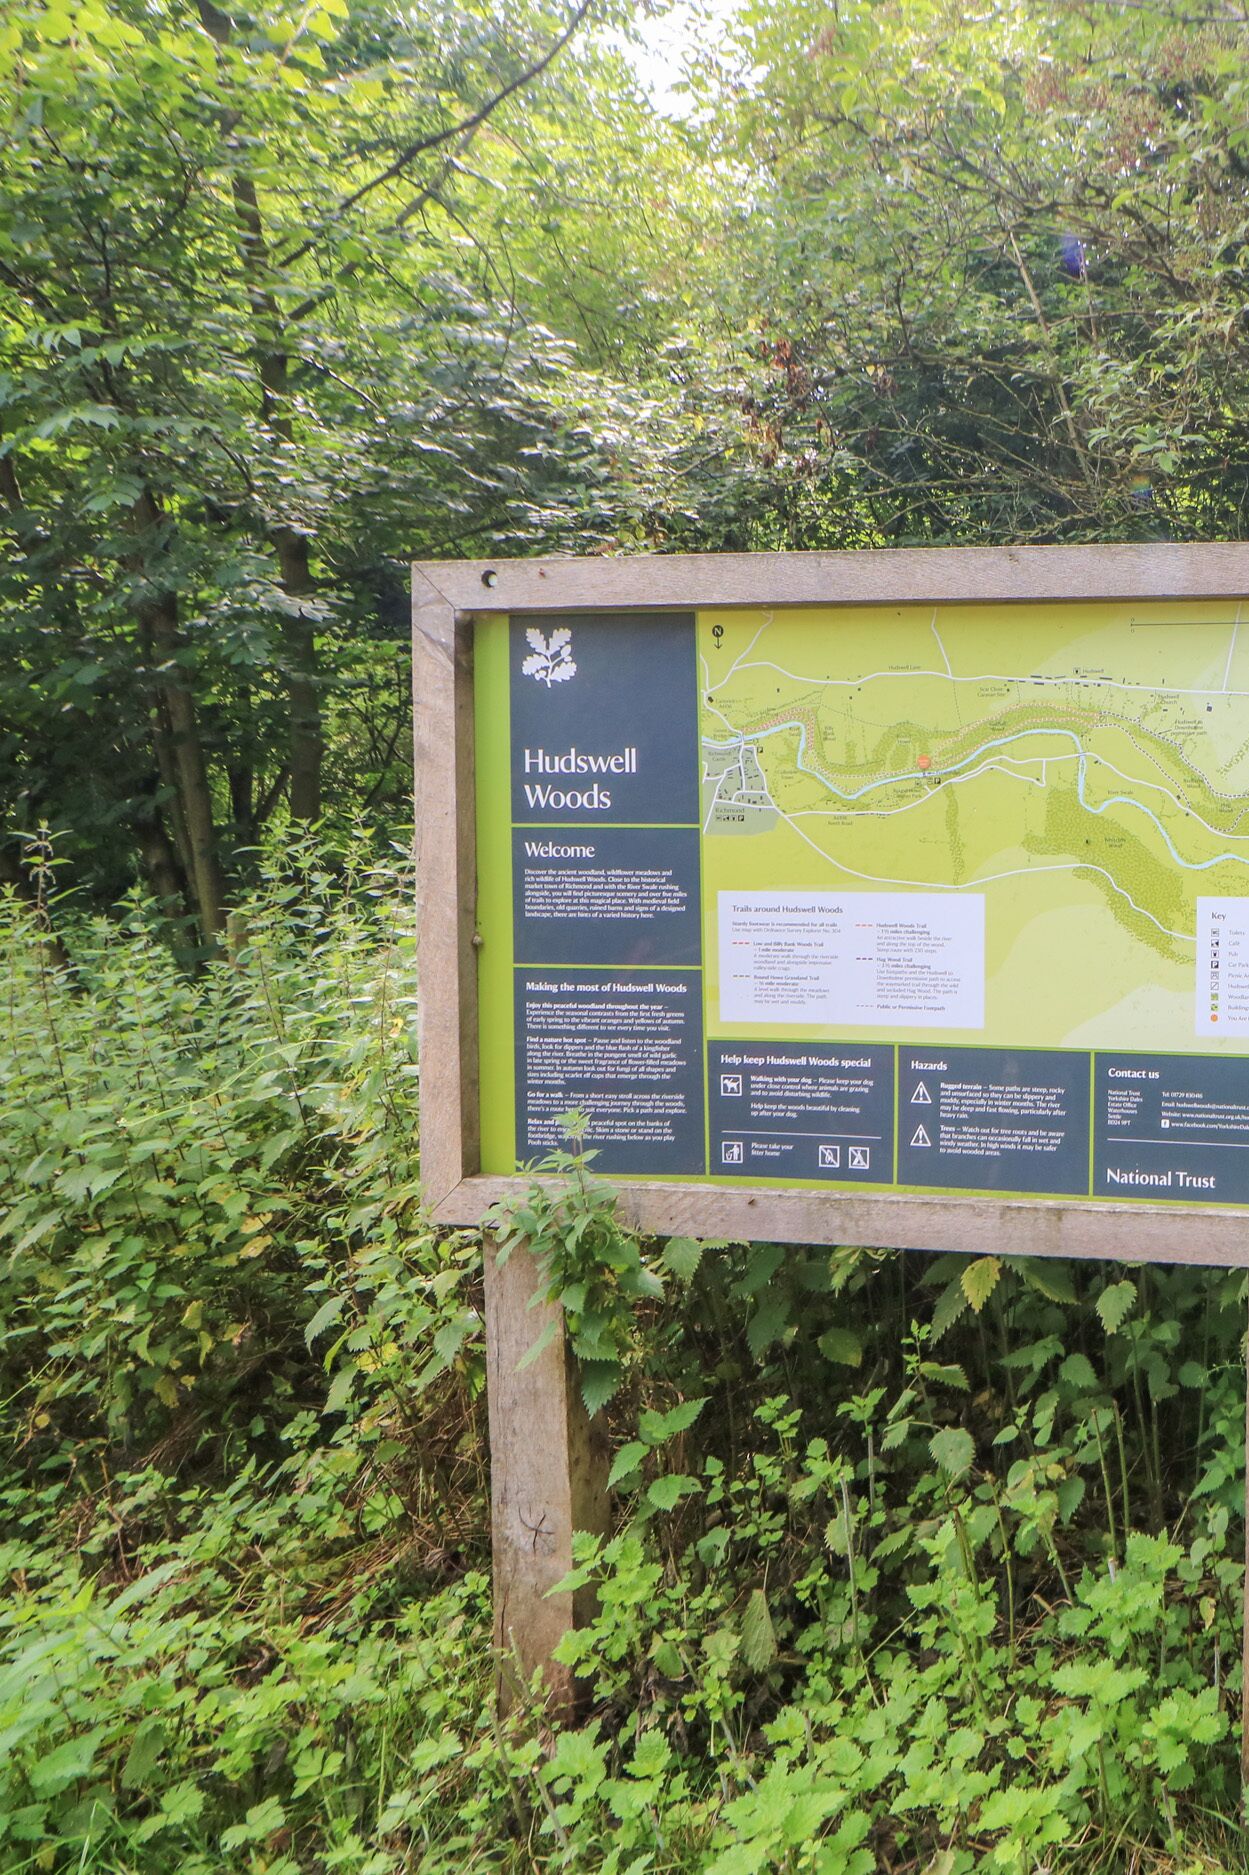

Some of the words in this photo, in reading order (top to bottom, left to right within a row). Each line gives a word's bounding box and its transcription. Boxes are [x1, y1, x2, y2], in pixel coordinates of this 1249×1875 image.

[524, 748, 637, 773] Hudswell
[524, 784, 611, 808] Woods
[525, 842, 595, 858] Welcome
[658, 883, 680, 892] rushing
[732, 905, 752, 913] Trails
[753, 905, 780, 913] around
[781, 905, 816, 913] Hudswell
[817, 906, 843, 914] Woods
[1212, 912, 1226, 921] Key
[526, 982, 558, 994] Making
[559, 982, 575, 991] the
[576, 983, 599, 992] most
[600, 983, 611, 992] of
[612, 983, 654, 992] Hudswell
[655, 983, 687, 993] Woods
[547, 1023, 576, 1032] something
[720, 1055, 742, 1067] Help
[743, 1055, 764, 1067] keep
[765, 1056, 807, 1066] Hudswell
[808, 1057, 839, 1067] Woods
[840, 1057, 871, 1070] special
[911, 1060, 947, 1071] Hazards
[1108, 1068, 1146, 1078] Contact
[1148, 1071, 1159, 1079] us
[783, 1090, 810, 1099] disturbing
[989, 1091, 1002, 1100] they
[1021, 1092, 1044, 1102] slippery
[940, 1096, 960, 1106] muddy,
[960, 1097, 987, 1107] especially
[1012, 1099, 1035, 1107] months.
[750, 1103, 763, 1111] Help
[763, 1103, 777, 1111] keep
[829, 1105, 837, 1113] by
[837, 1105, 860, 1114] cleaning
[785, 1111, 798, 1119] dog.
[1107, 1168, 1173, 1186] National
[1175, 1171, 1216, 1188] Trust
